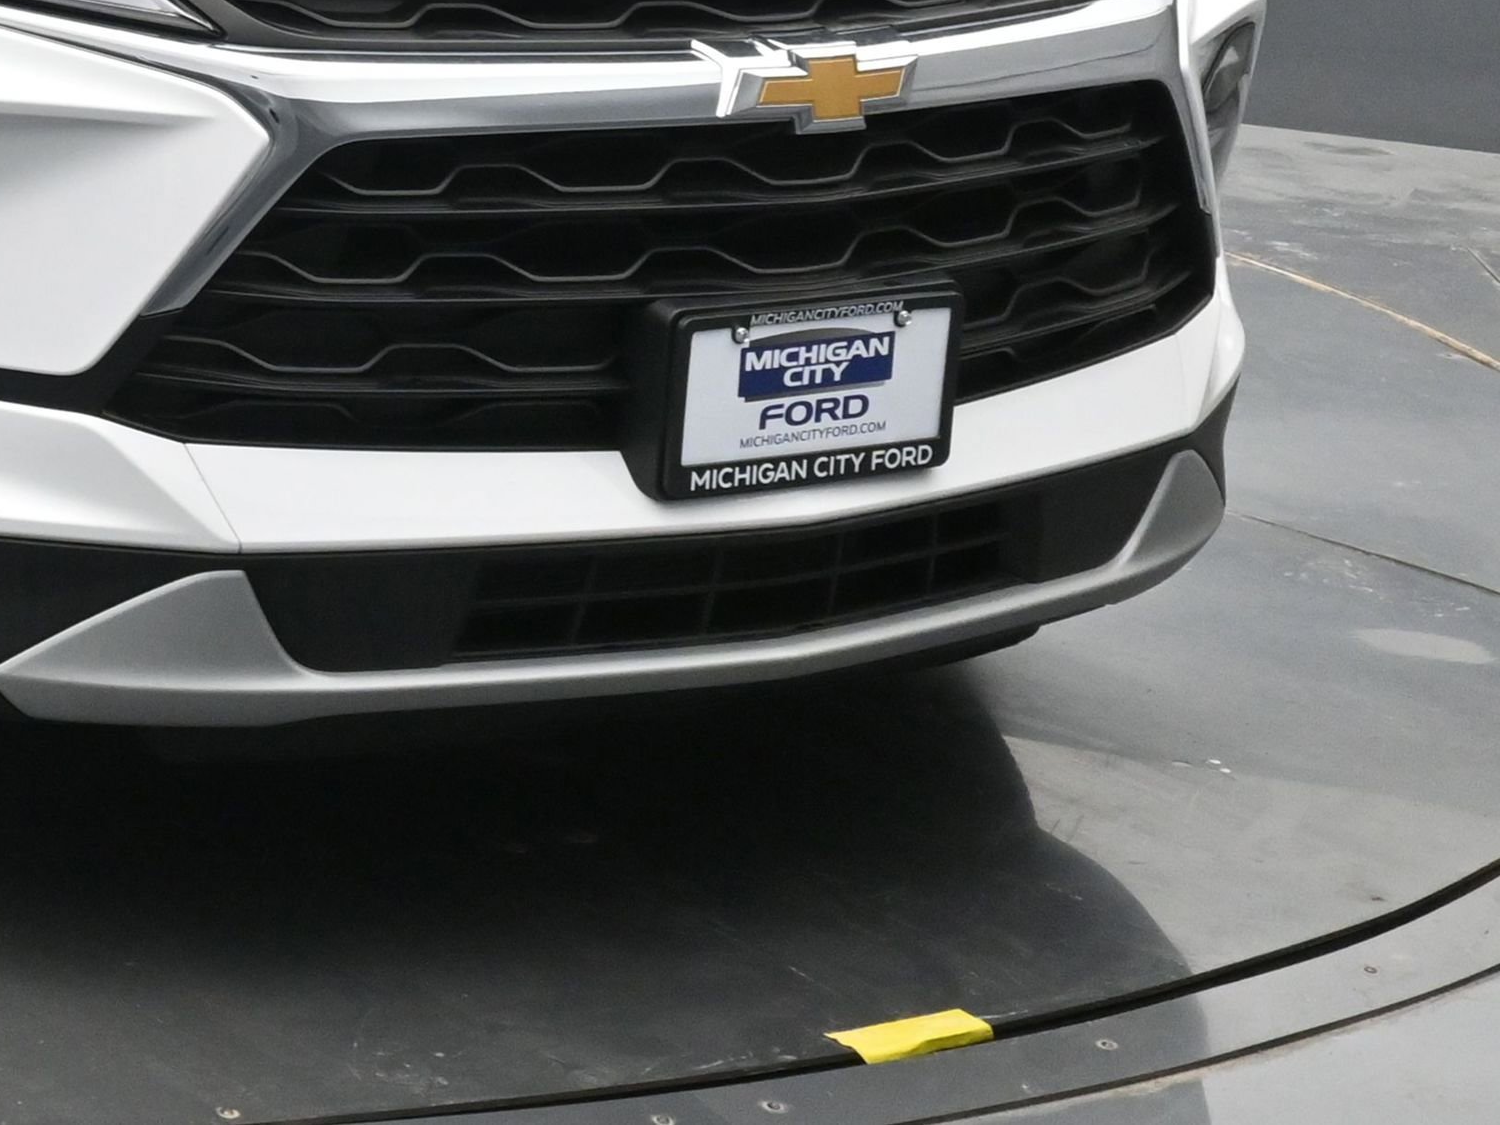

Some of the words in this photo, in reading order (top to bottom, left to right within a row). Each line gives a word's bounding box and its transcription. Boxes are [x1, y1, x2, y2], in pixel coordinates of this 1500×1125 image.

[751, 301, 903, 326] MICHIGANCITYFORD.COM
[744, 336, 890, 372] MICHIGAN
[783, 362, 850, 388] CITY
[758, 394, 870, 430] FORD
[739, 421, 887, 449] MICHIGANCITYFORD.COM
[689, 459, 808, 492] MICHIGAN
[813, 452, 865, 478] CITY
[870, 445, 933, 471] FORD
